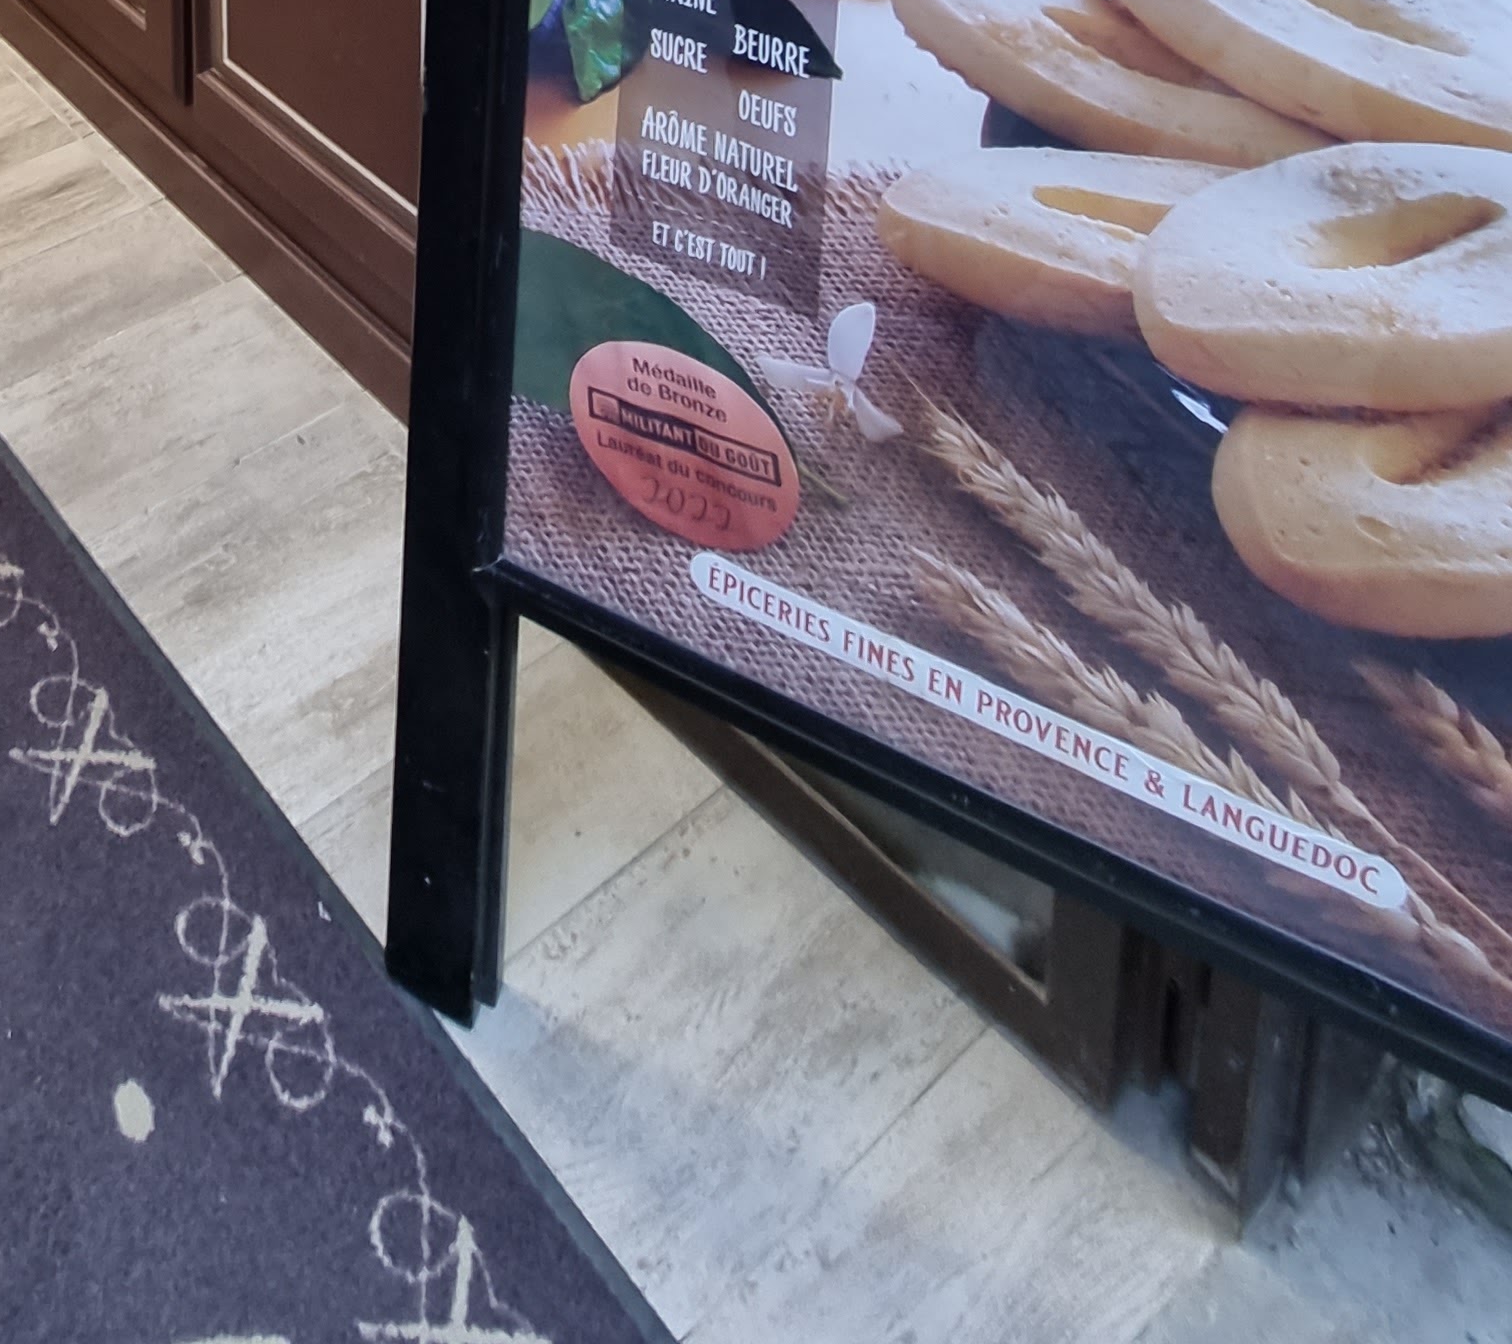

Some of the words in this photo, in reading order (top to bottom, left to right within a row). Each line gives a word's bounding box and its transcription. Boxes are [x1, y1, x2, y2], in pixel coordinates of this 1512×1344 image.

[649, 27, 709, 74] SUCRE
[732, 23, 811, 79] BEURRE
[738, 89, 798, 138] OEUFS
[640, 105, 708, 157] ARÔME
[714, 130, 800, 193] NATUREL
[642, 148, 693, 191] FLEUR
[697, 165, 794, 230] D'ORANGER
[652, 220, 672, 248] ET
[674, 228, 716, 264] C'EST
[719, 241, 757, 277] TOUT
[626, 376, 652, 396] de
[657, 383, 729, 424] Bronze
[631, 356, 718, 400] Médaille
[620, 406, 695, 447] MILITANT
[697, 433, 721, 459] DU
[725, 448, 772, 477] GOÛT
[596, 429, 663, 470] Lauréat
[666, 458, 691, 480] du
[694, 467, 778, 513] concours
[707, 561, 832, 644] ÉPICERIES
[841, 629, 916, 684] FINES
[927, 666, 964, 706] EN
[976, 690, 1131, 781] PROVENCE
[1143, 768, 1165, 799] &
[1181, 783, 1380, 896] LANGUEDOC
